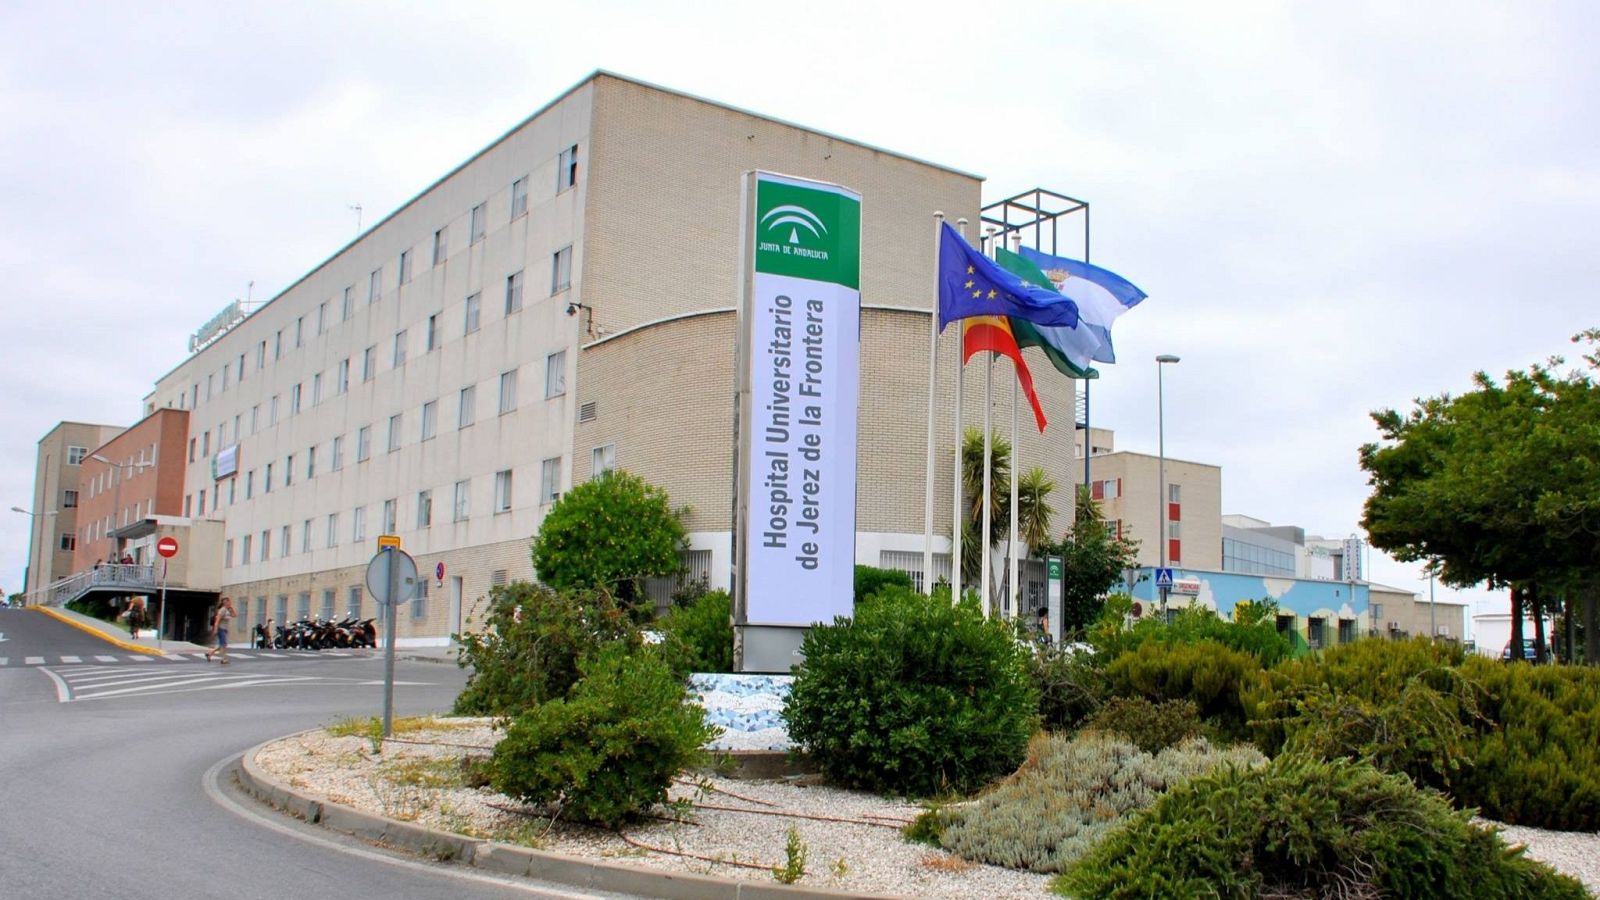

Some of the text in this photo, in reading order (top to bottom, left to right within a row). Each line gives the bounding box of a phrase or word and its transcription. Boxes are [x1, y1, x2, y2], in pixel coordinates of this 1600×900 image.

[759, 242, 780, 252] JUNTA
[783, 245, 791, 255] DE
[763, 294, 793, 549] Hospital Universitario
[795, 299, 824, 570] de Jerez de la Frontera
